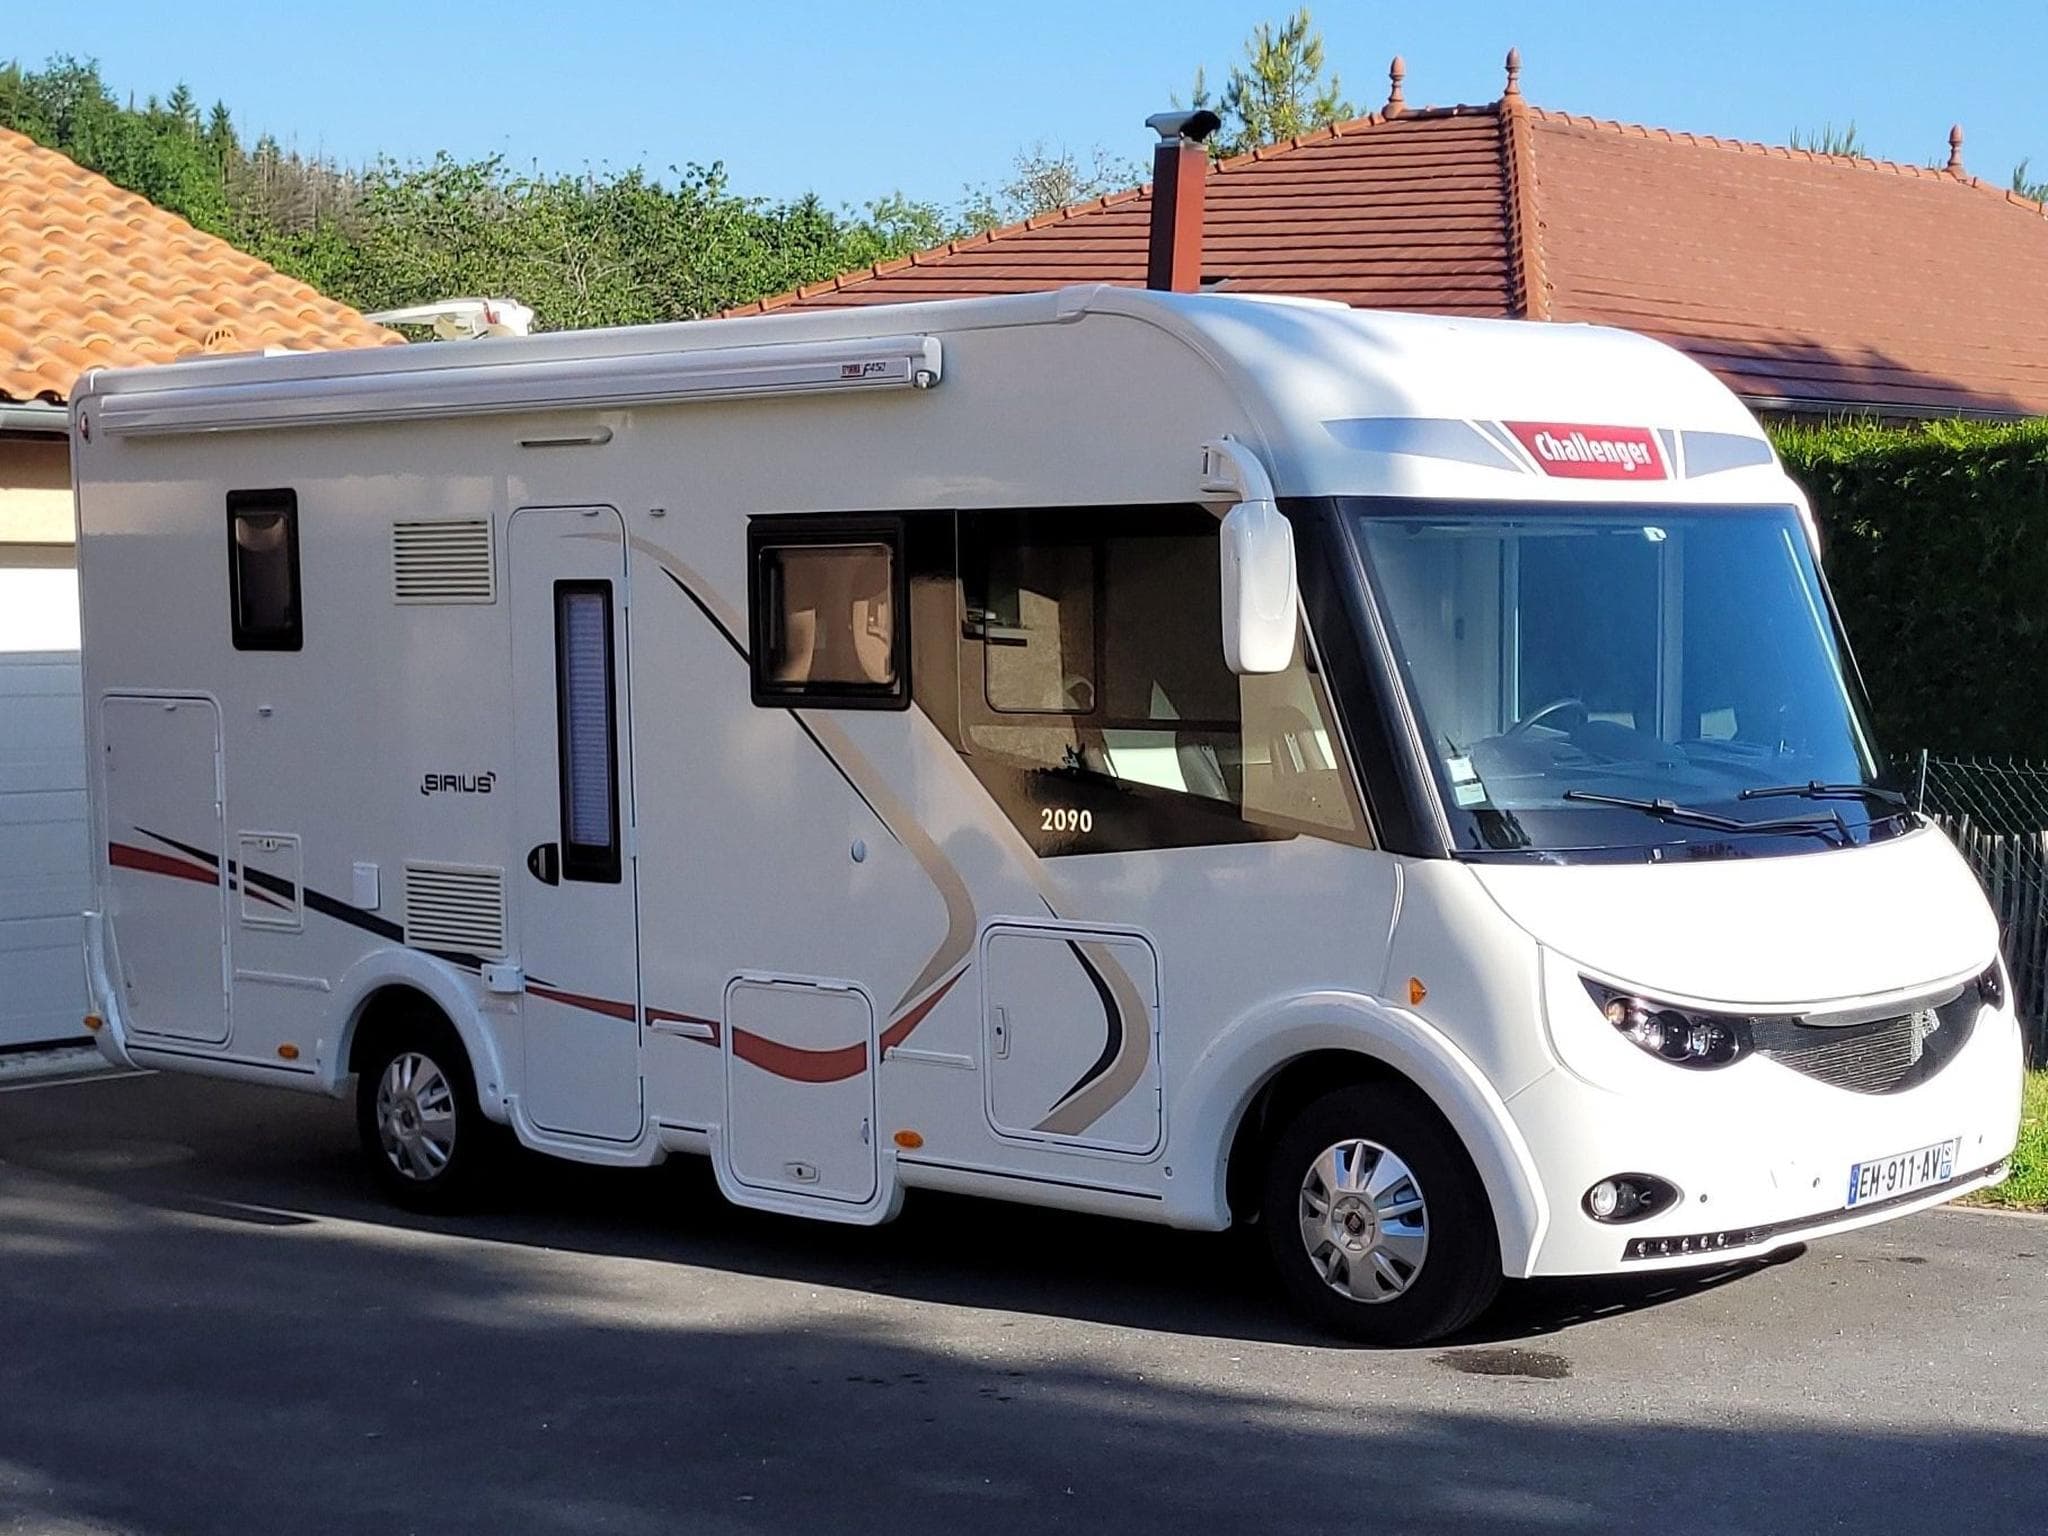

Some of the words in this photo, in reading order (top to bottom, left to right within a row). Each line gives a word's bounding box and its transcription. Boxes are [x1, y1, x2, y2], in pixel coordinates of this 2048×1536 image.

[1534, 431, 1653, 472] Challenger
[423, 773, 493, 794] SIRIUS
[1041, 807, 1093, 833] 2090
